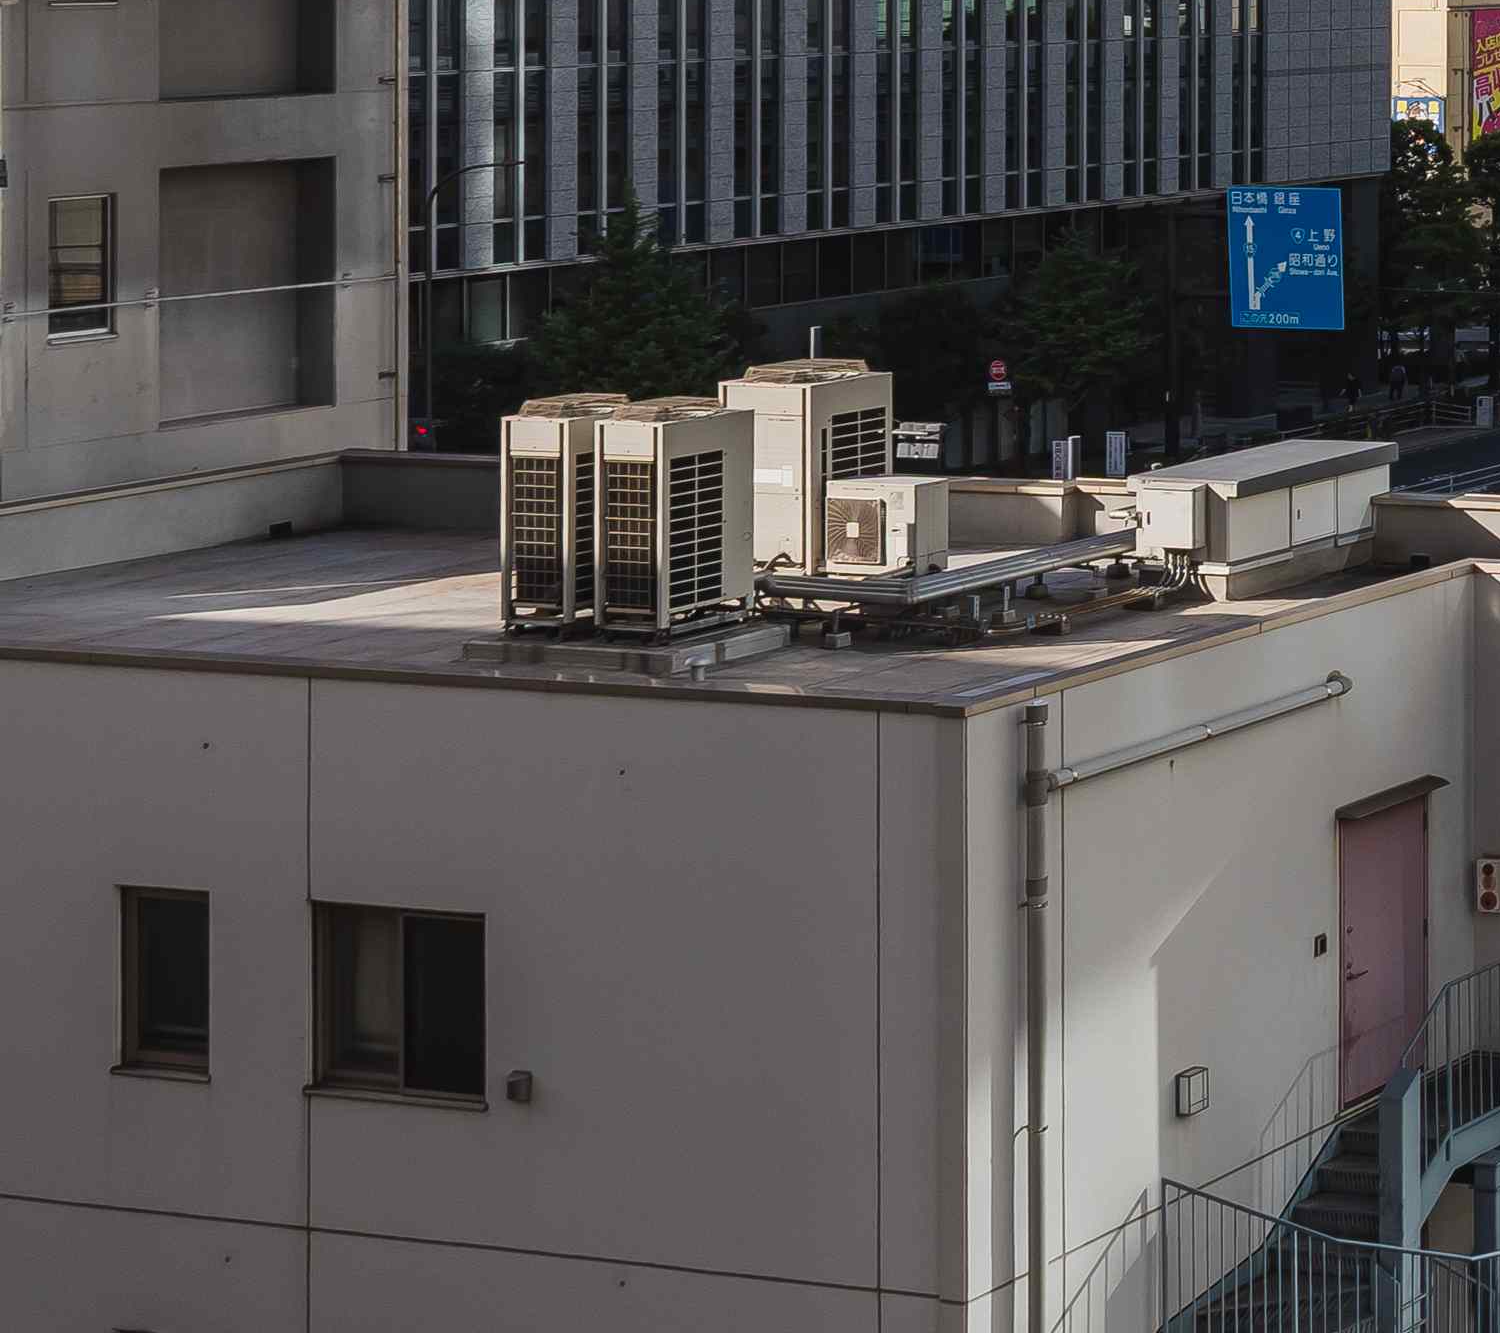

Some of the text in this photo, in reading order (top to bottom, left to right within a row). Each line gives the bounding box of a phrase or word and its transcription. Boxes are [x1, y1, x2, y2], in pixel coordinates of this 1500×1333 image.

[1231, 191, 1301, 205] 日本橋 銀座
[1308, 229, 1336, 242] 上野
[1289, 253, 1338, 267] 昭和通り
